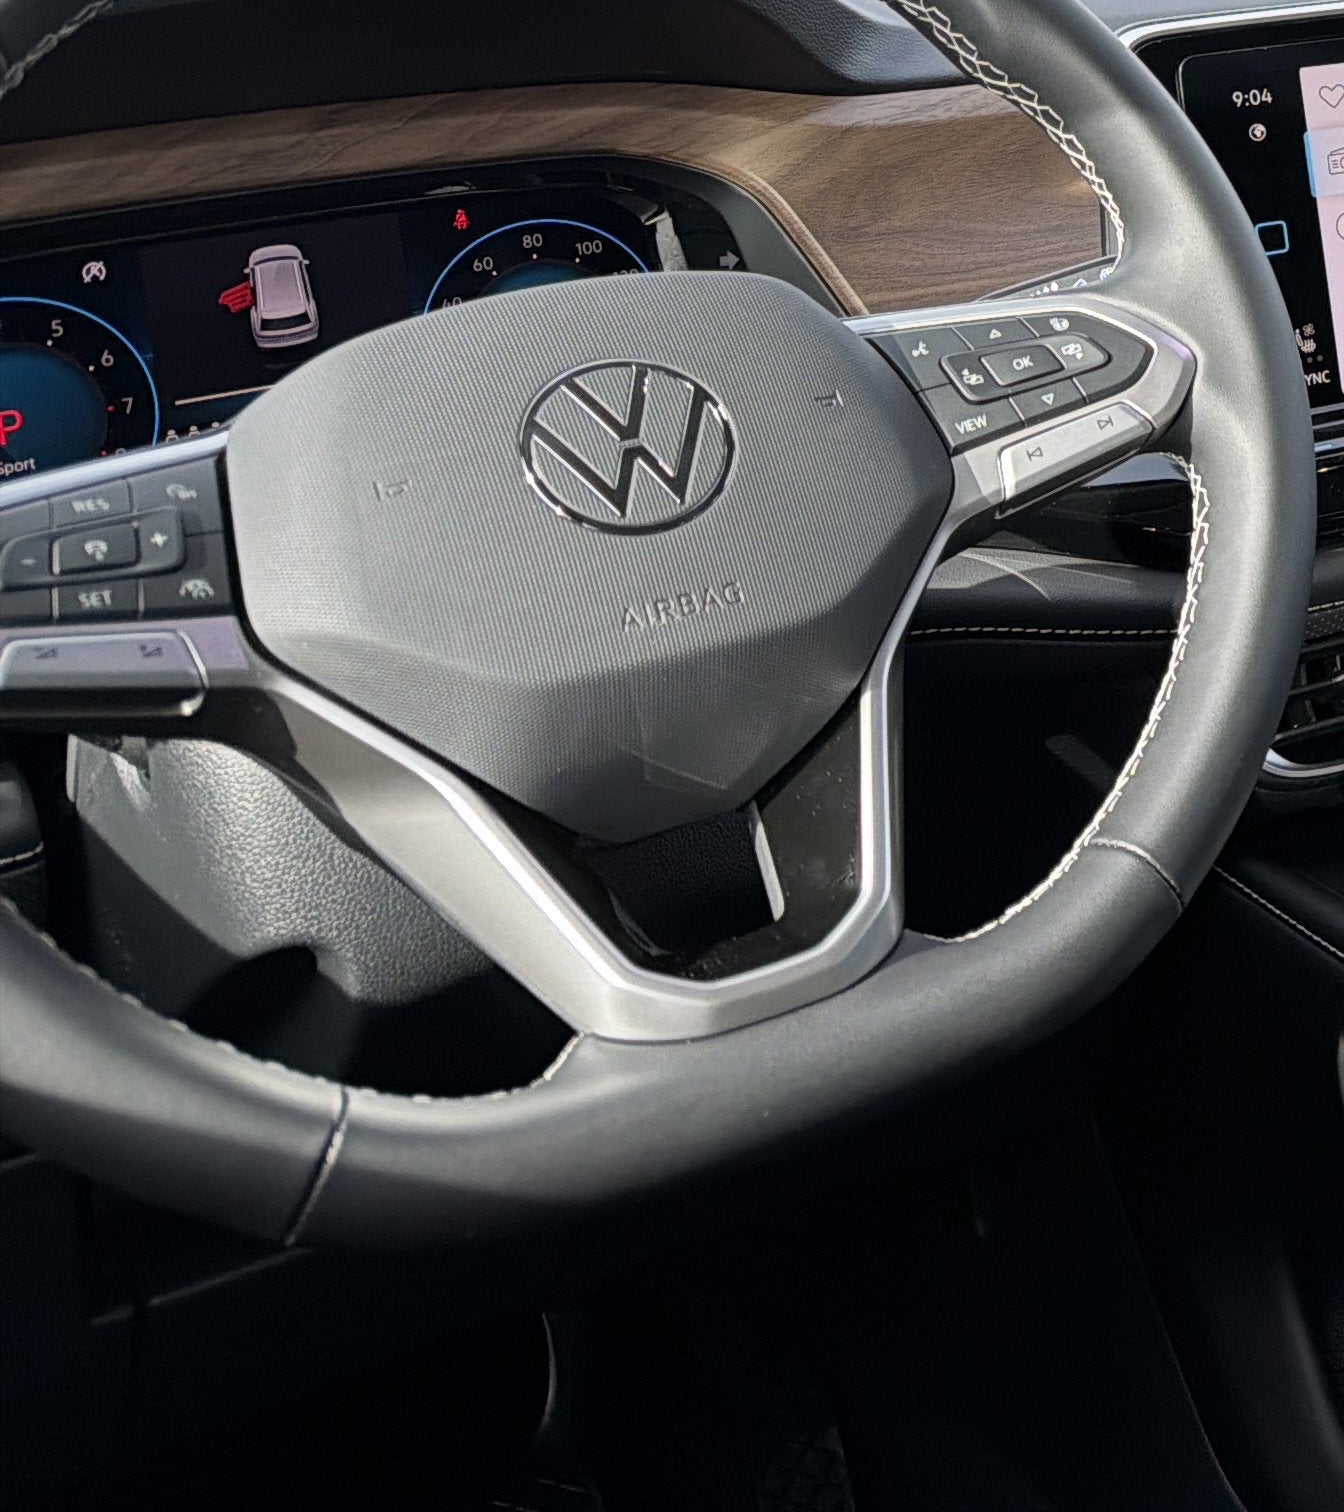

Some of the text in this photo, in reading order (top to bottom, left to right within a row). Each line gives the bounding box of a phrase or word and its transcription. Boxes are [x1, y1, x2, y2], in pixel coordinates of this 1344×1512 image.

[1232, 88, 1273, 107] 9:04
[522, 233, 543, 249] 80
[575, 240, 603, 256] 100
[473, 256, 494, 272] 60
[51, 320, 64, 338] 5
[101, 349, 115, 367] 6
[1012, 355, 1034, 371] OK
[1304, 369, 1331, 386] YNC
[121, 396, 133, 415] 7
[0, 409, 25, 446] P
[954, 414, 988, 434] VIEW
[72, 498, 110, 514] RES
[78, 589, 113, 608] SET
[621, 582, 746, 632] AIRBAG
